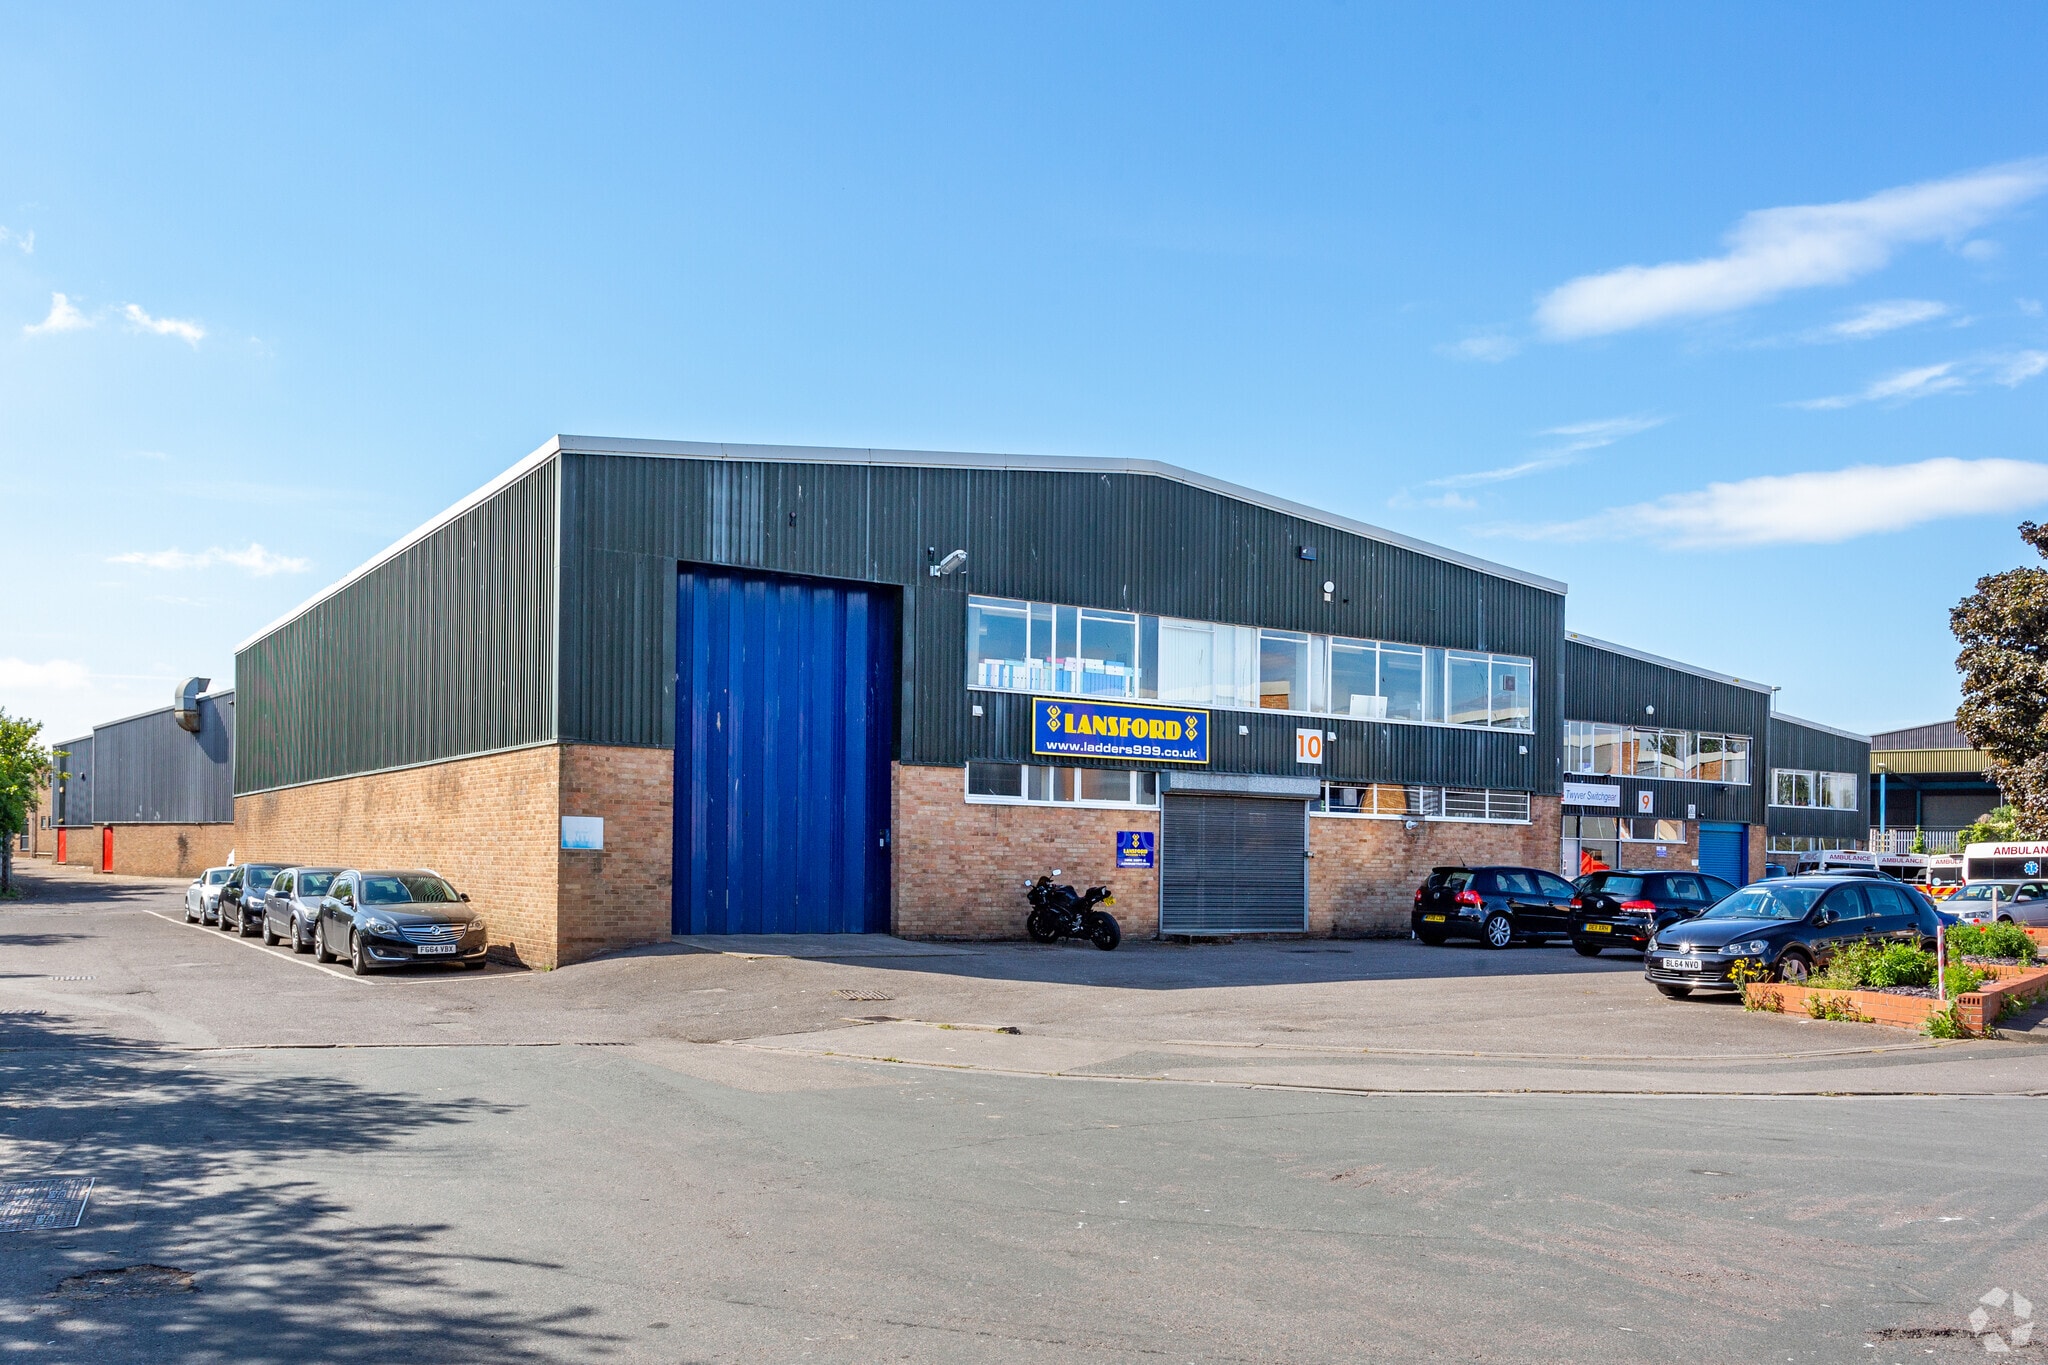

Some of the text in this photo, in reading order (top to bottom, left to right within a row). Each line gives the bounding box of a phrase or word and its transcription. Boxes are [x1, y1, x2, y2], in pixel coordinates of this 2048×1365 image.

[1064, 713, 1181, 740] LANSFORD
[1046, 741, 1198, 758] www.ladders999.co.uk
[1298, 735, 1321, 758] 10
[1566, 789, 1617, 803] Twyver Switchgear
[1642, 795, 1650, 809] 9
[1829, 854, 1871, 862] AMBULANCE
[1666, 959, 1699, 969] BL64 NVO
